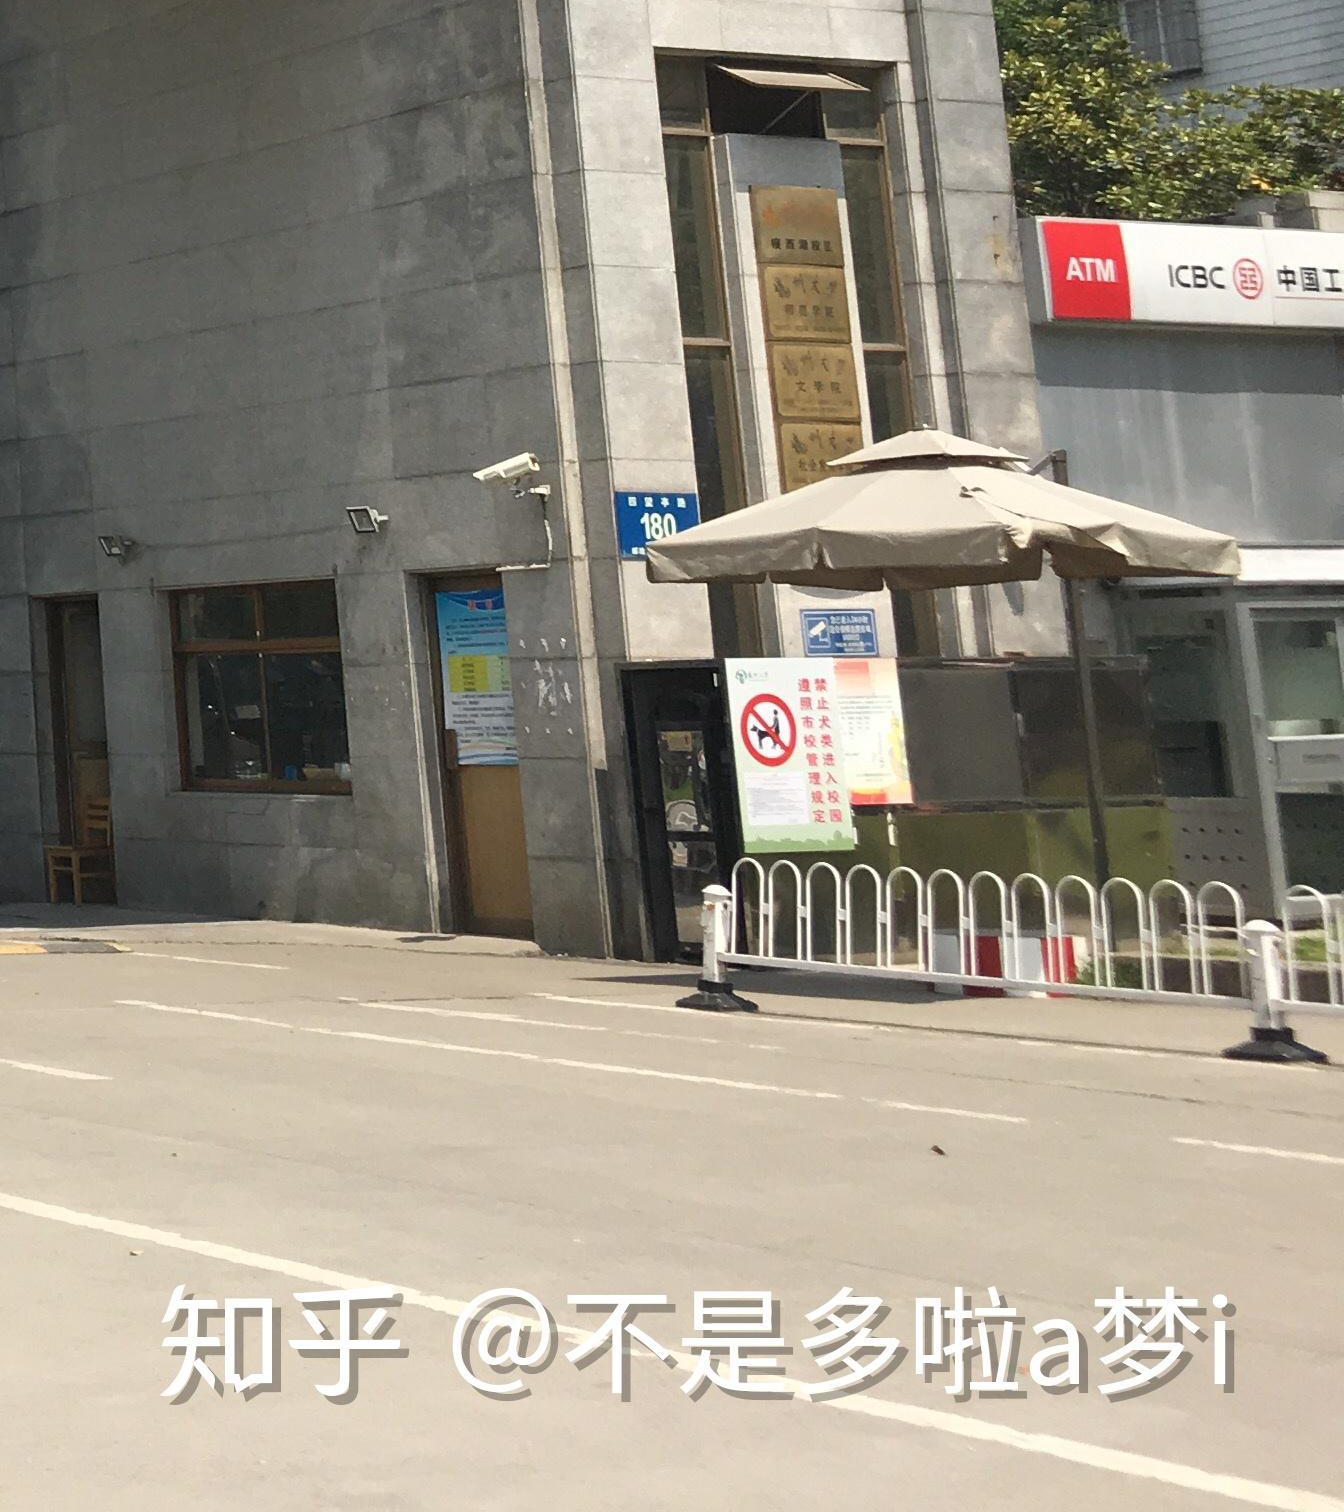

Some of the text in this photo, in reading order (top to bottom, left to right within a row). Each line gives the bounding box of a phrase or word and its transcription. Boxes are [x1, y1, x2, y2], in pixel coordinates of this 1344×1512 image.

[1066, 256, 1117, 284] ATM
[1168, 264, 1343, 292] ICBC 中国工
[640, 512, 677, 540] 180
[814, 678, 843, 824] 禁止犬类进入校园
